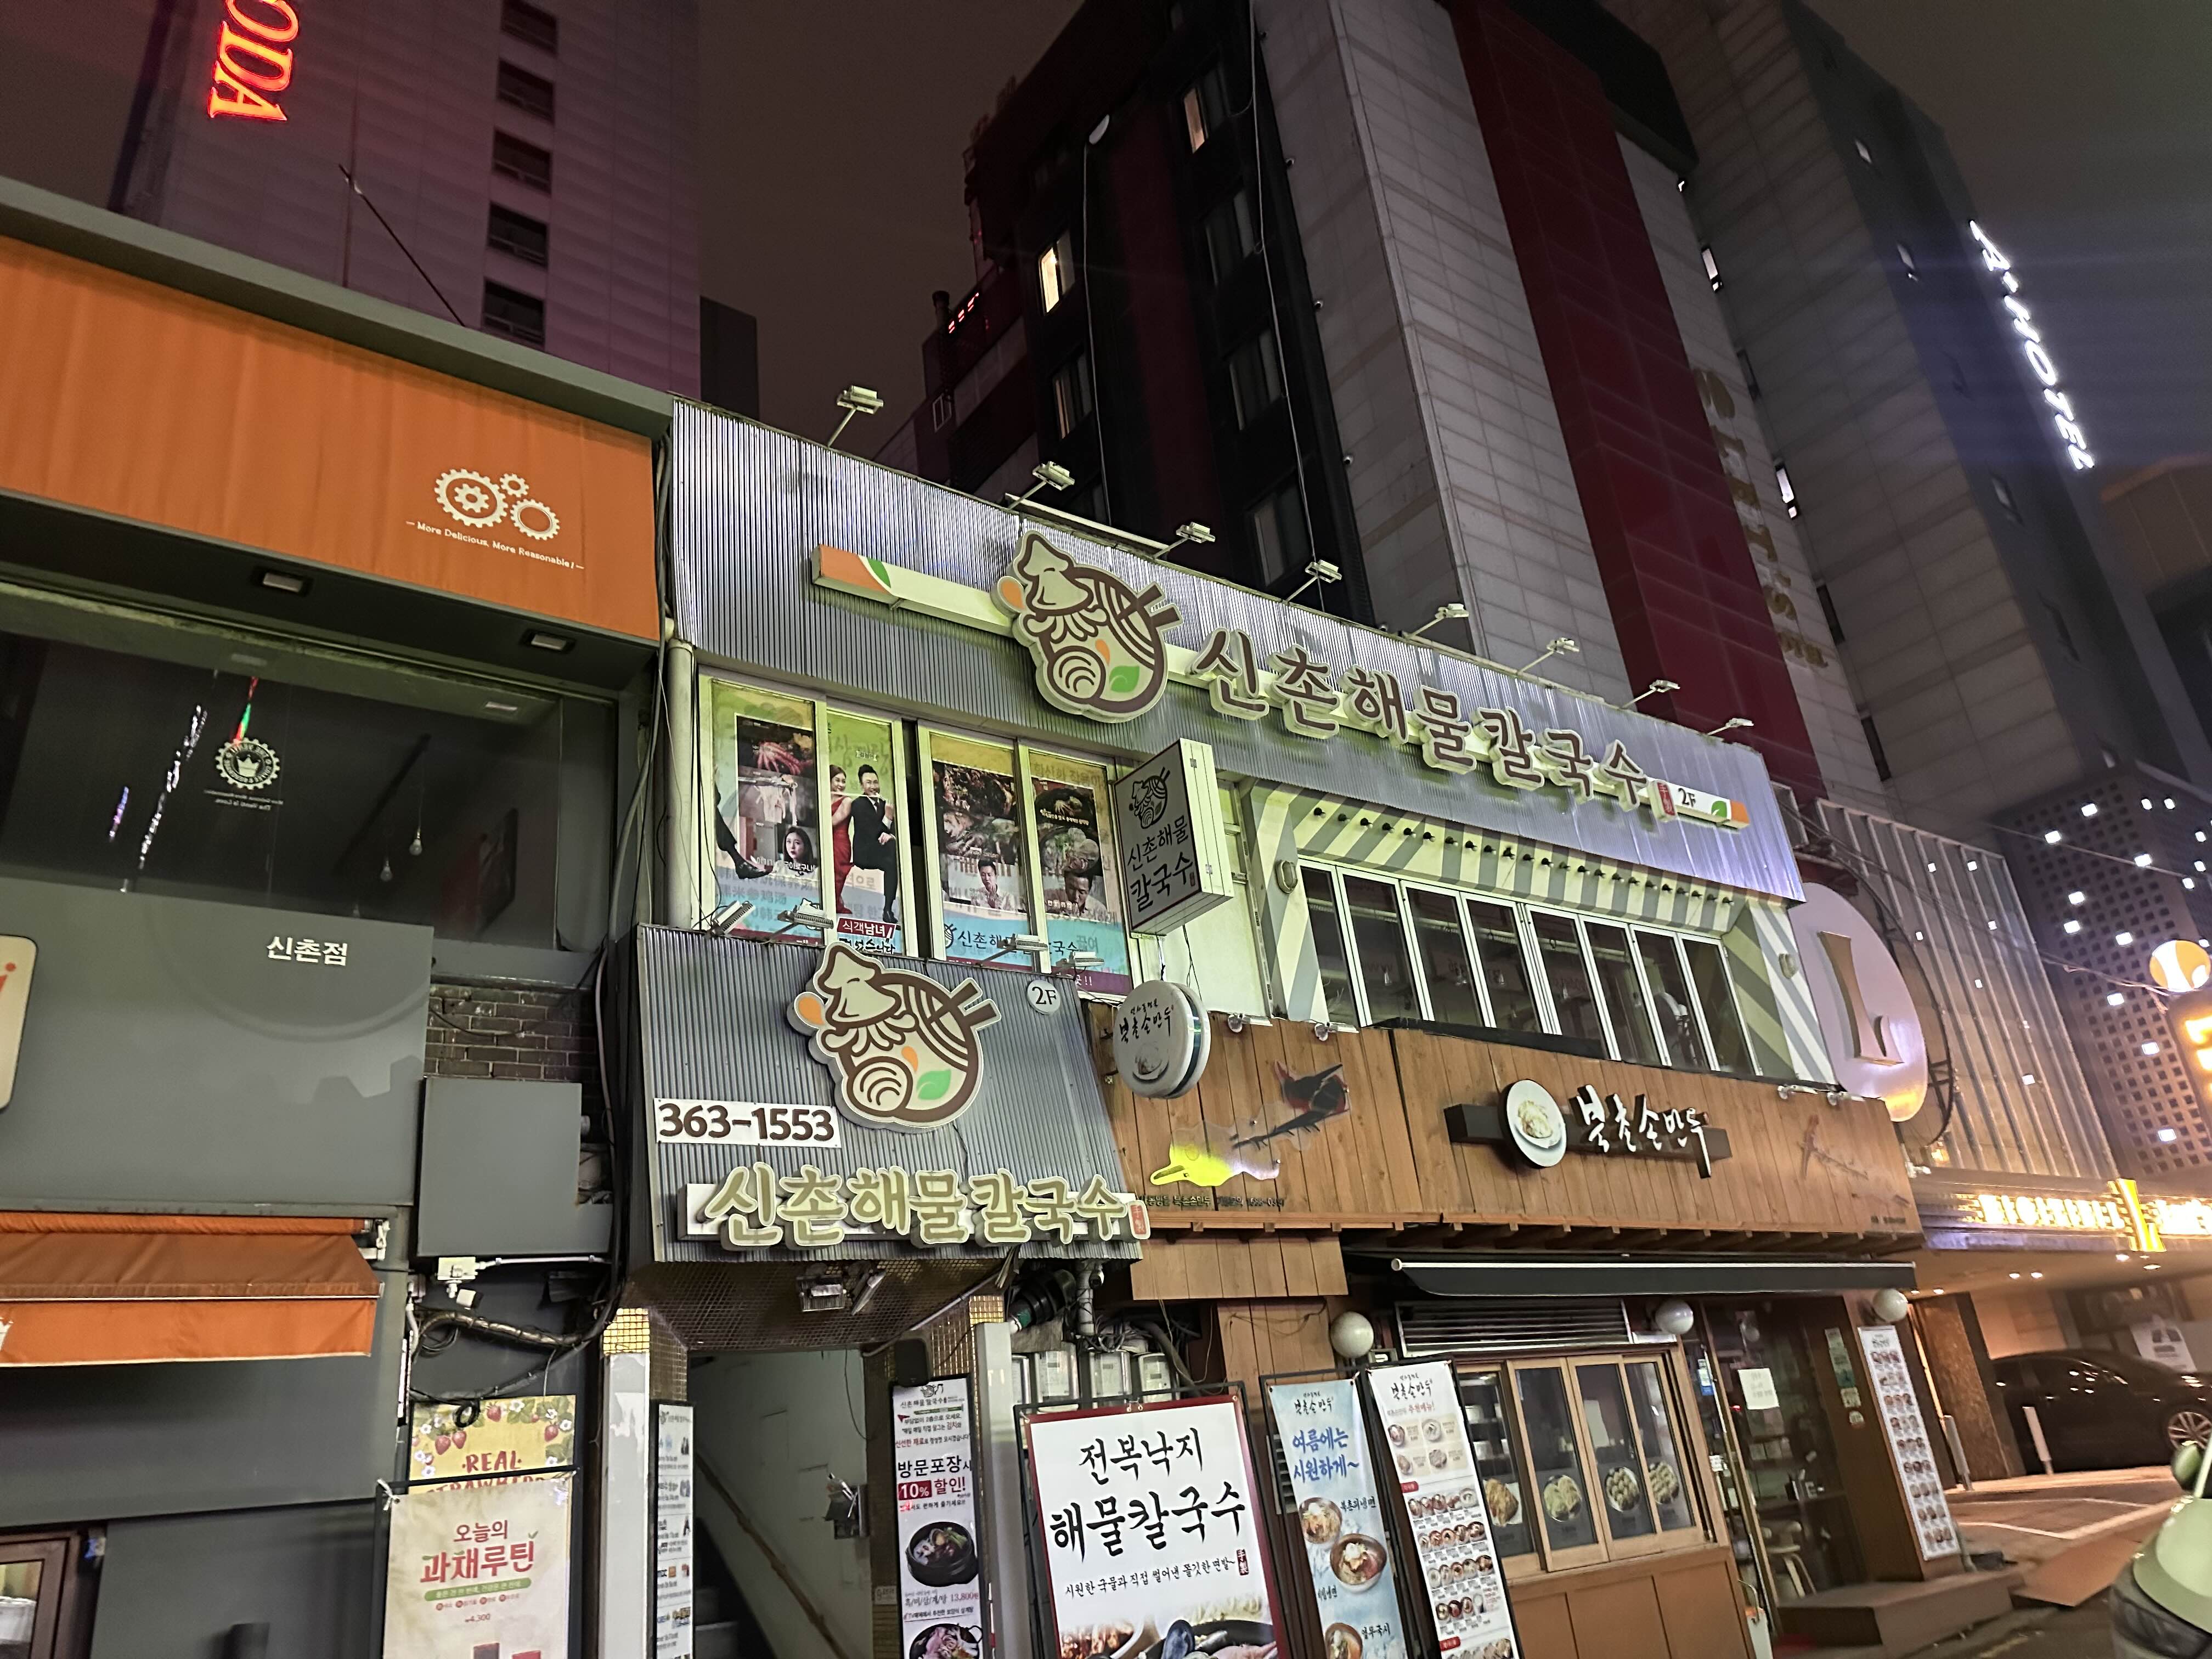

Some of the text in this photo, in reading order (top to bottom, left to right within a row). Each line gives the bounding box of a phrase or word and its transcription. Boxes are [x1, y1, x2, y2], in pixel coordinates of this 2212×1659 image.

[417, 521, 442, 535] More
[493, 540, 516, 554] More
[1186, 629, 1647, 811] 신촌해물칼국수
[1678, 787, 1696, 808] 2F
[1127, 815, 1189, 872] 신촌해물
[1130, 851, 1193, 912] 칼국수
[842, 920, 886, 936] 식객남녀
[957, 930, 1079, 956] 신촌해국수
[267, 936, 348, 966] 신촌점
[1032, 986, 1057, 1005] 2F
[658, 1102, 834, 1142] 363-1553
[1575, 1084, 1711, 1178] 북촌손만두
[702, 1161, 1128, 1246] 신촌해물칼국수
[1293, 1426, 1348, 1454] 여름에는
[466, 1450, 521, 1474] REAL
[1079, 1427, 1204, 1485] 전복낙지
[901, 1476, 966, 1499] 10% 할인!
[453, 1520, 508, 1543] 오늘의
[1049, 1481, 1245, 1562] 해물칼국수
[420, 1541, 534, 1583] 과채루틴
[1065, 1581, 1096, 1599] 시원한
[1097, 1575, 1128, 1593] 국물과
[1130, 1571, 1149, 1587] 직접
